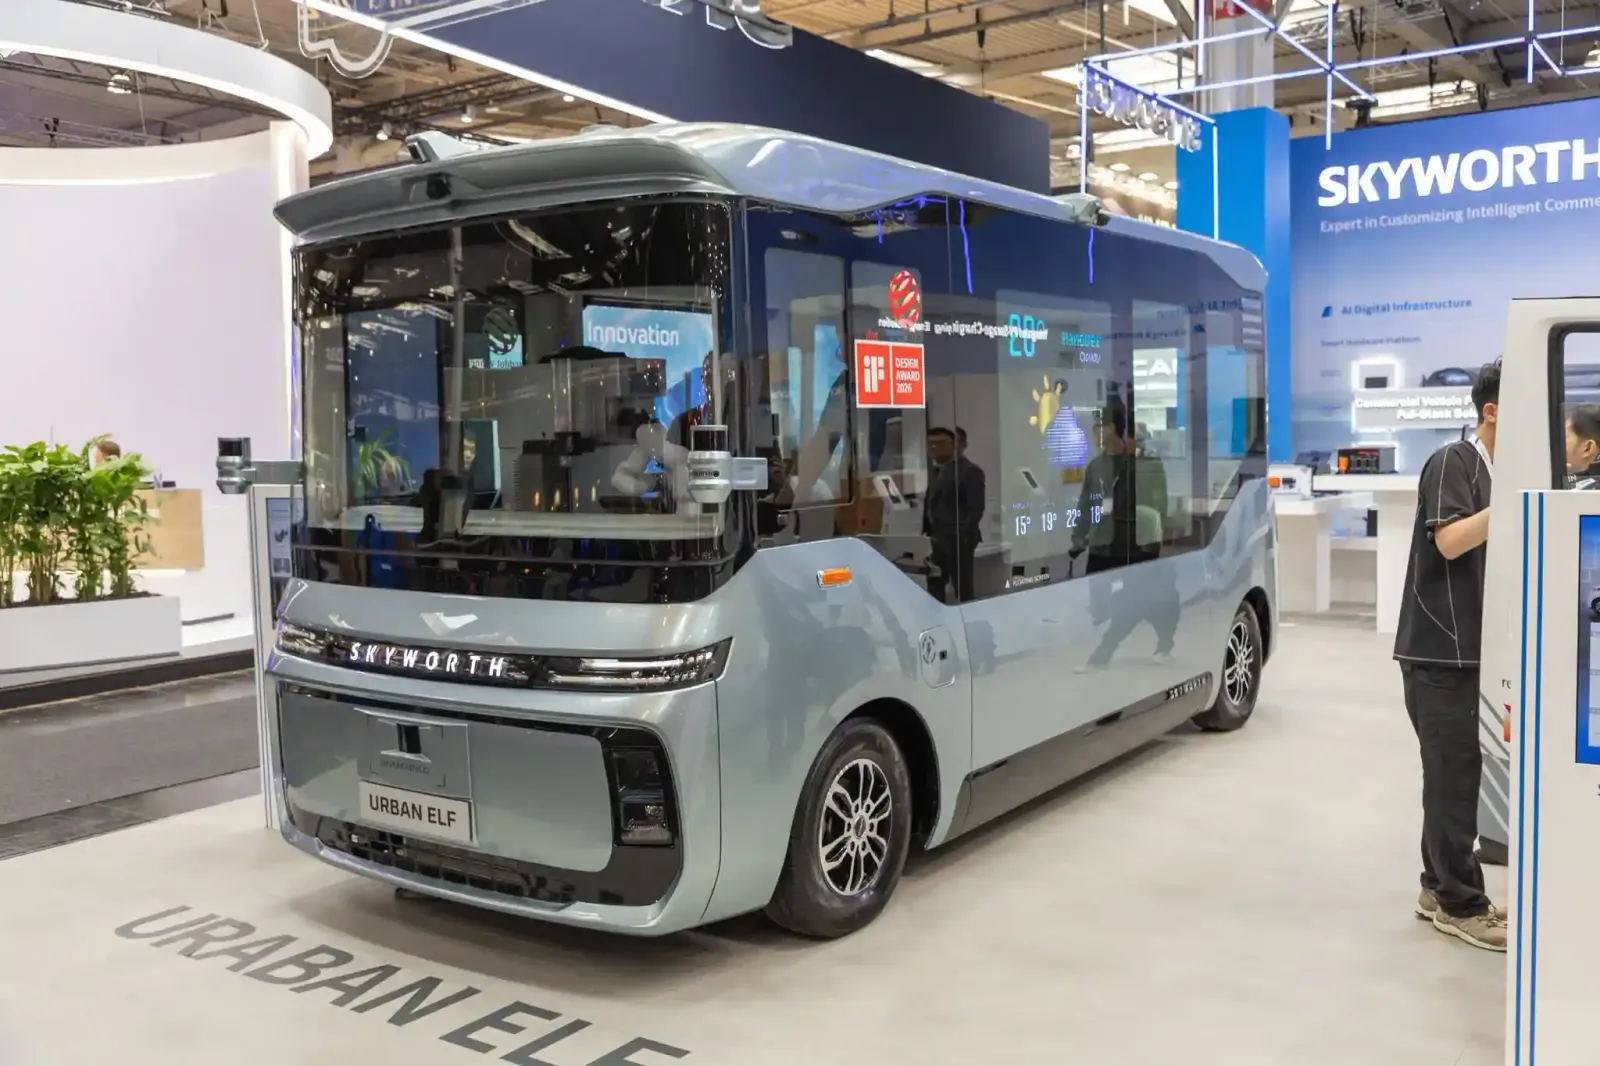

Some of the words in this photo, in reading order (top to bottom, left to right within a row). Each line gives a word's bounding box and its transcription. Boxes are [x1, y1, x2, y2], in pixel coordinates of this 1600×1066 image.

[1318, 138, 1600, 207] SKYWORTH
[1320, 218, 1362, 234] Expert
[1365, 216, 1377, 229] in
[1379, 208, 1463, 227] Customizing
[1466, 200, 1541, 219] Intelligent
[1354, 303, 1390, 316] Digital
[1393, 299, 1472, 312] Infrastructure
[588, 322, 680, 347] Innovation
[895, 358, 919, 370] DESIGN
[896, 371, 921, 382] AWARD
[896, 383, 913, 394] 2026
[350, 641, 504, 677] SKYWORTH
[369, 793, 423, 821] URBAN
[427, 806, 457, 828] ELF
[115, 904, 482, 1027] URABAN
